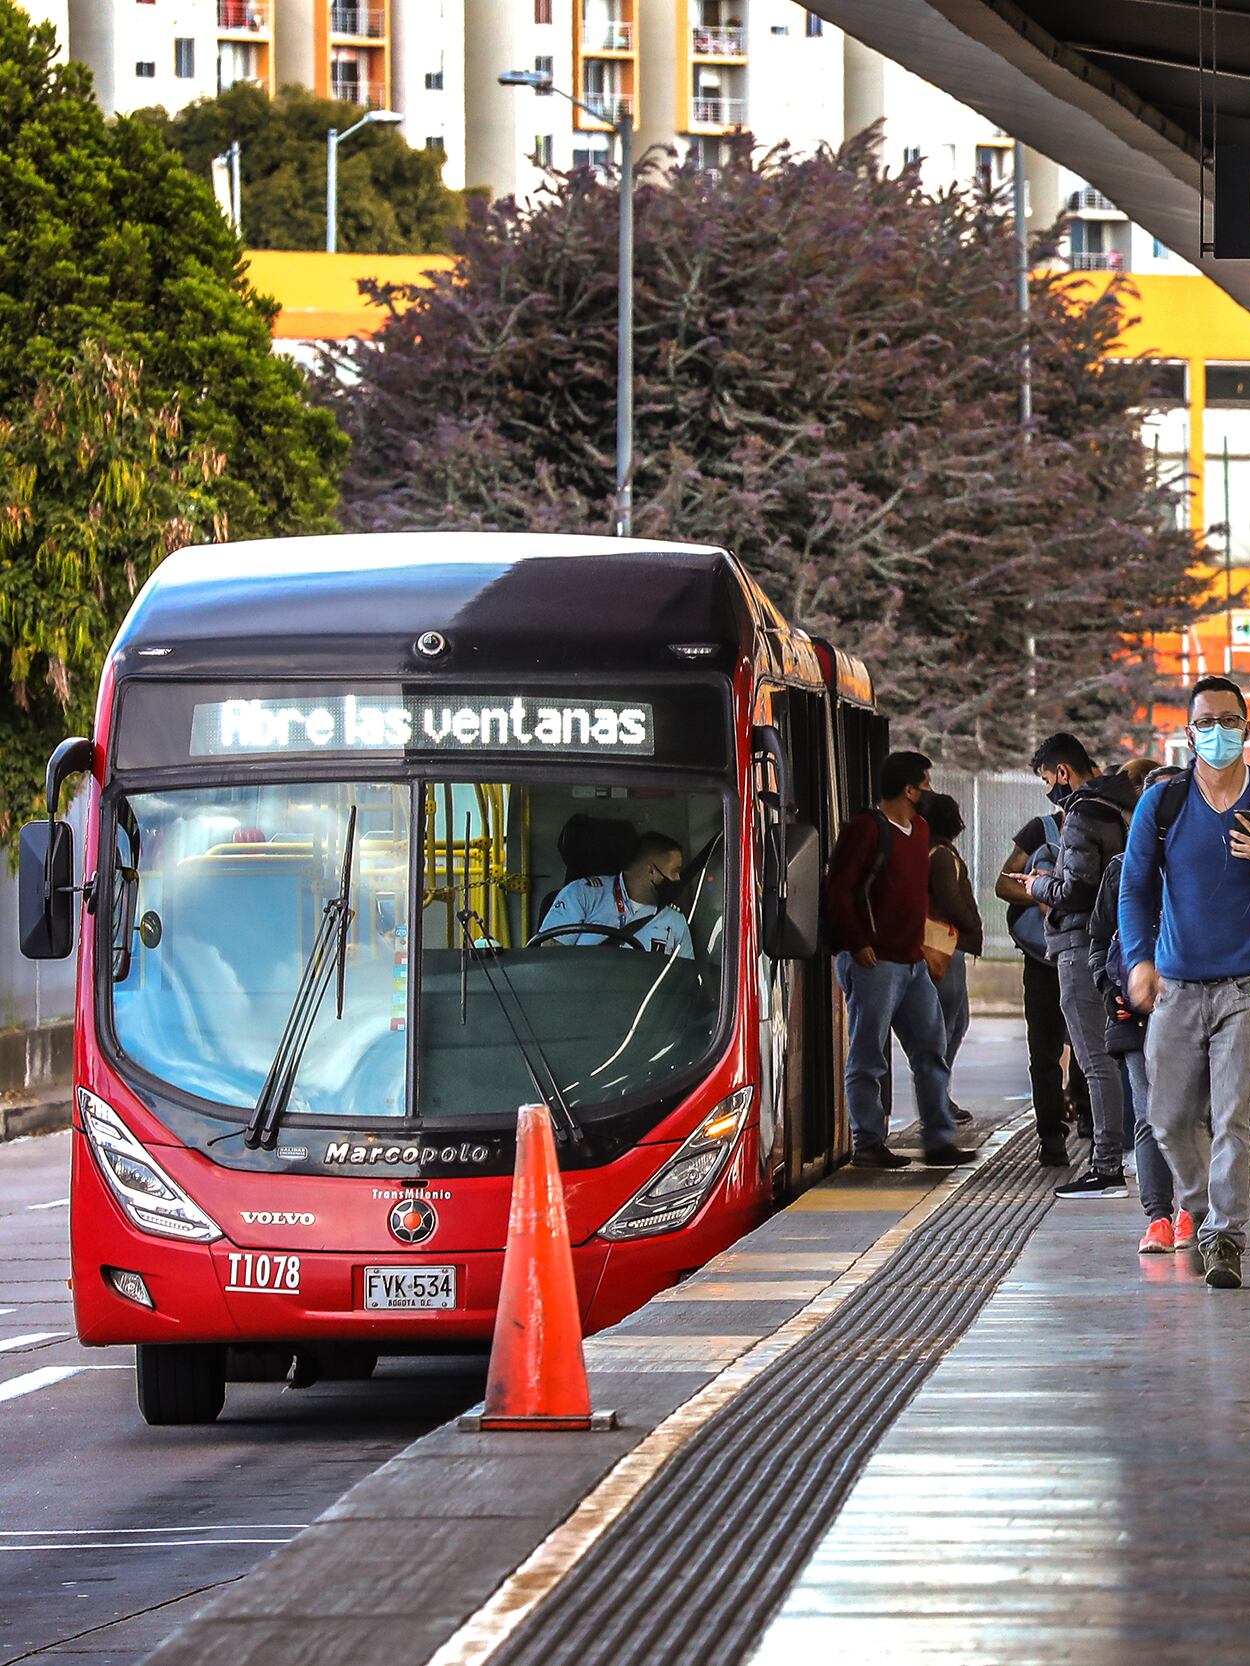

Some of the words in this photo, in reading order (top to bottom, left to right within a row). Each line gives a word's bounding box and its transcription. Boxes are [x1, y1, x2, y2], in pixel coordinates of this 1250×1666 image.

[221, 698, 335, 746] Abre
[346, 694, 411, 745] las
[424, 697, 645, 744] ventanas
[325, 1143, 488, 1164] Marcopolo
[241, 1212, 315, 1225] VOLVO
[228, 1253, 300, 1289] T1078
